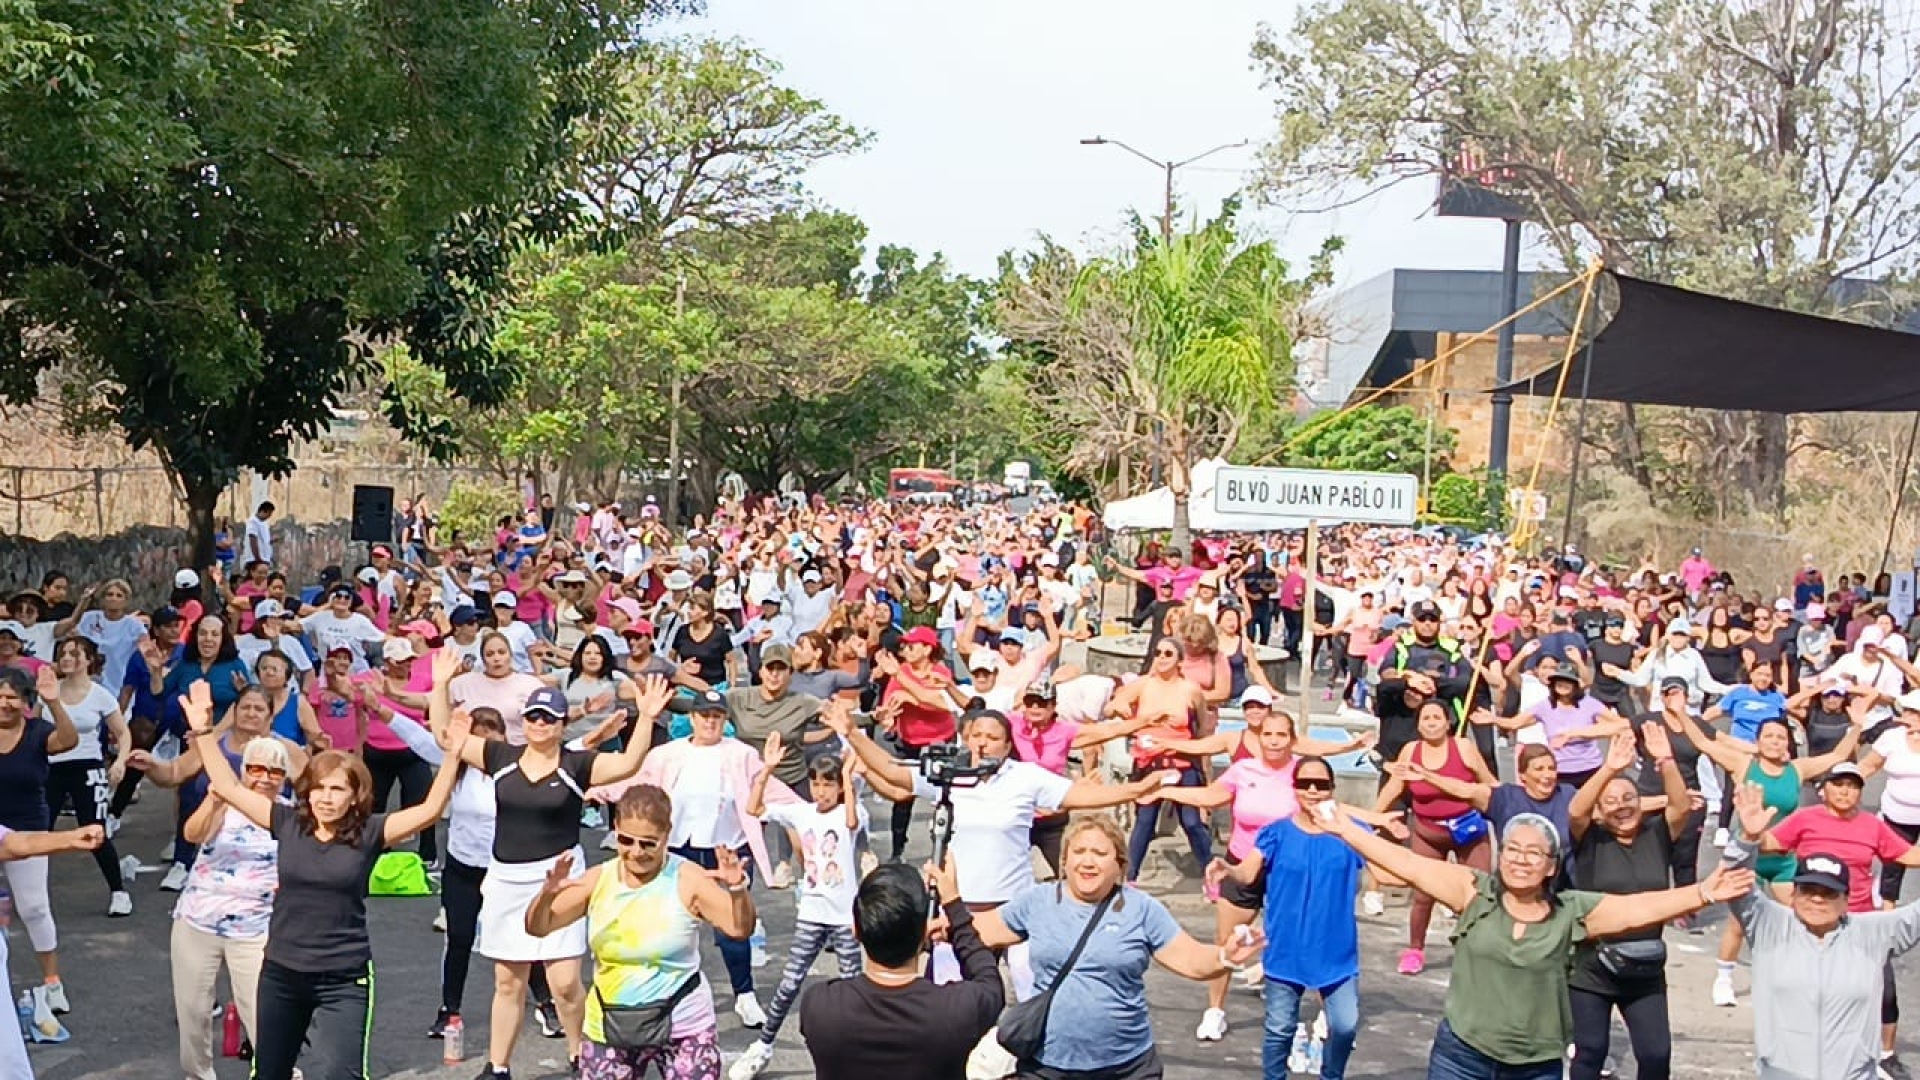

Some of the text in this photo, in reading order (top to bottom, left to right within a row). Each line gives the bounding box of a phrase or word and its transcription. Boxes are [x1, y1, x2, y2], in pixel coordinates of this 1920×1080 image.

[1227, 479, 1402, 510] BLVD JUAN PABLO II
